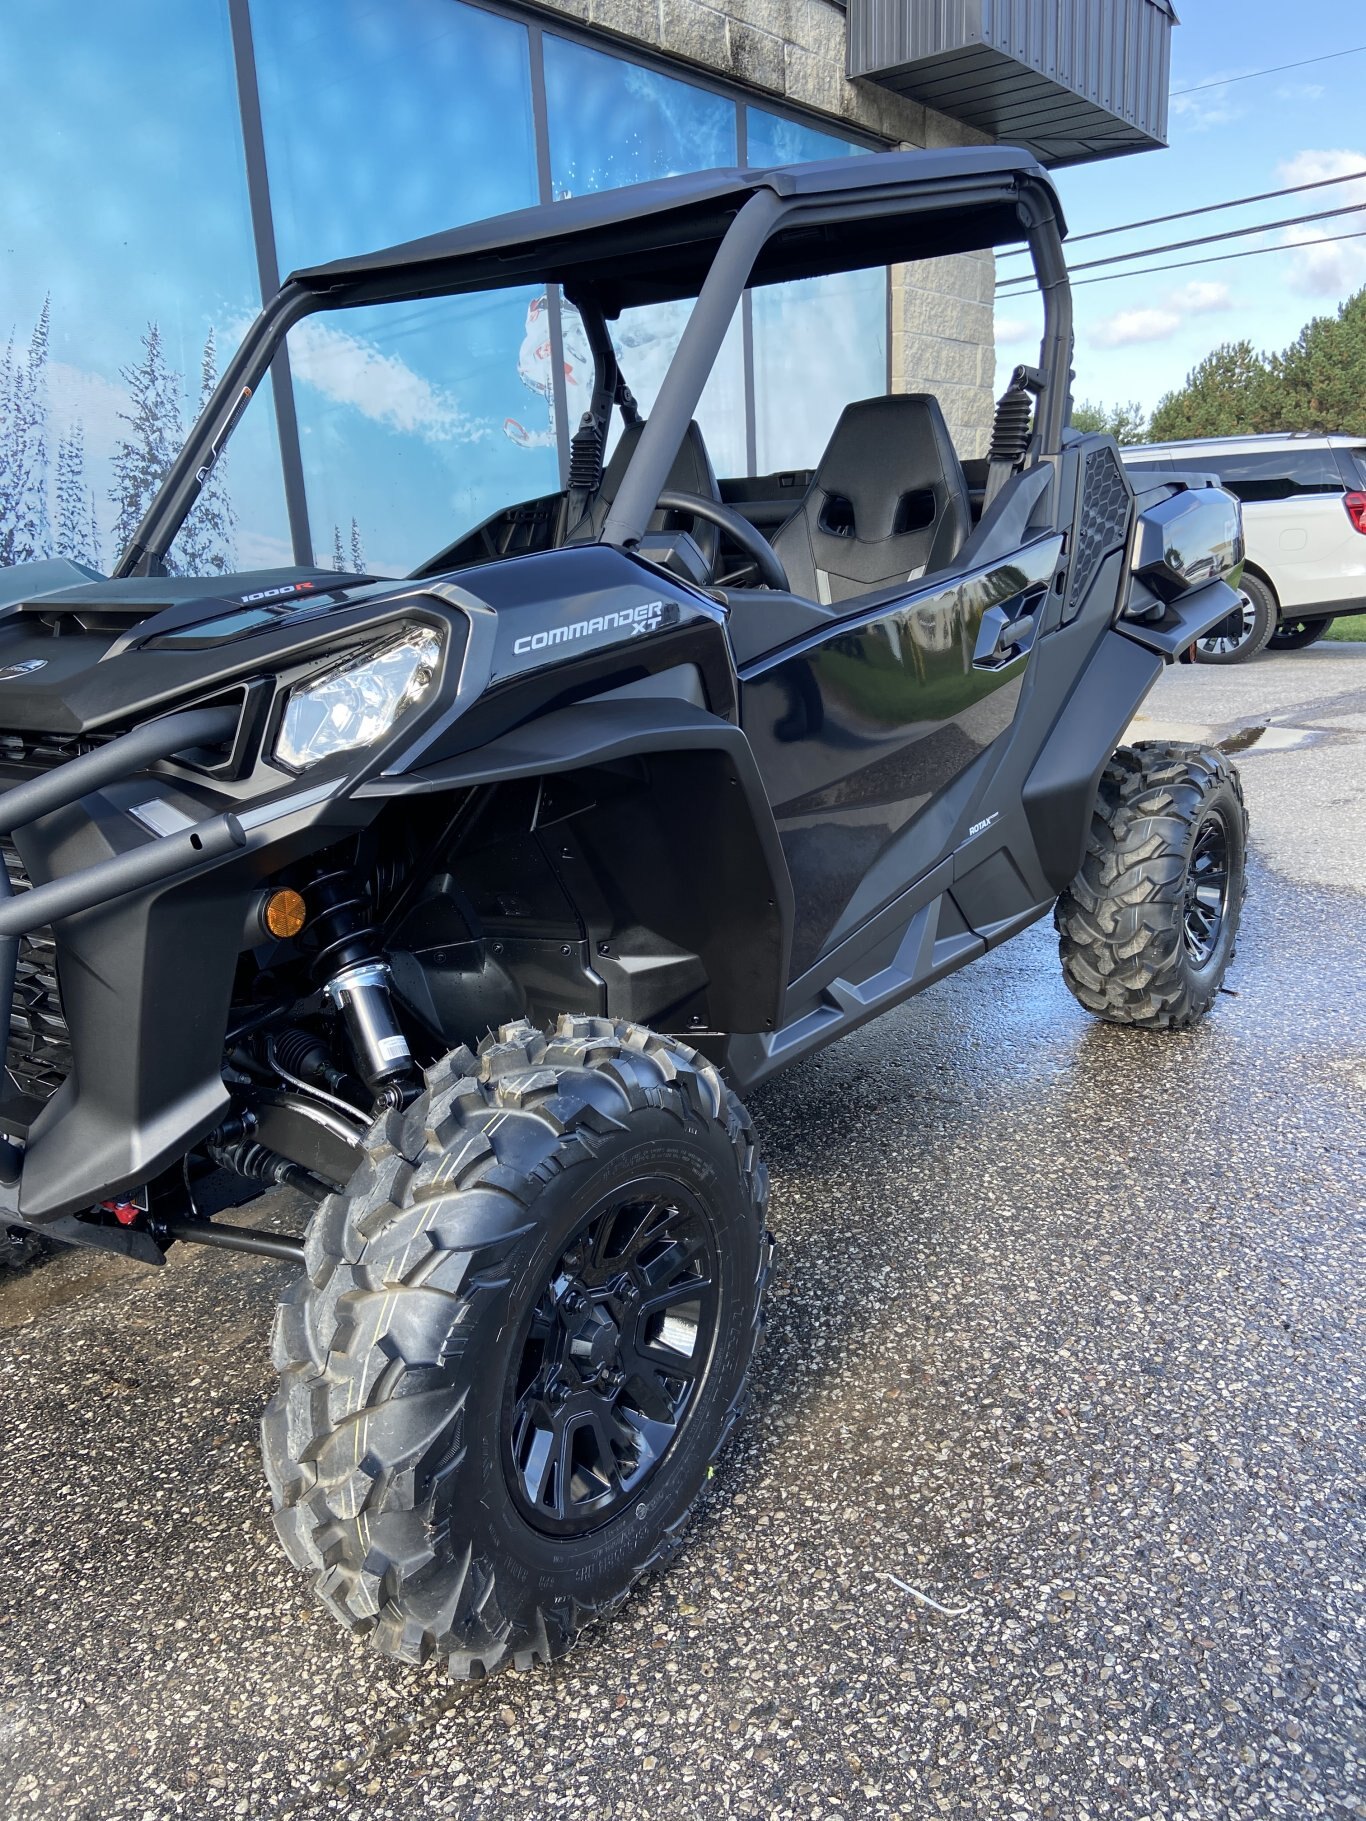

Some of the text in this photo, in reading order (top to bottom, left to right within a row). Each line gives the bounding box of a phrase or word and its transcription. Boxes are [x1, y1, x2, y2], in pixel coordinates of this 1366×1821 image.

[241, 582, 315, 603] 1000R
[513, 601, 662, 654] COMMANDER
[630, 616, 661, 636] XT
[969, 815, 994, 836] ROTAX
